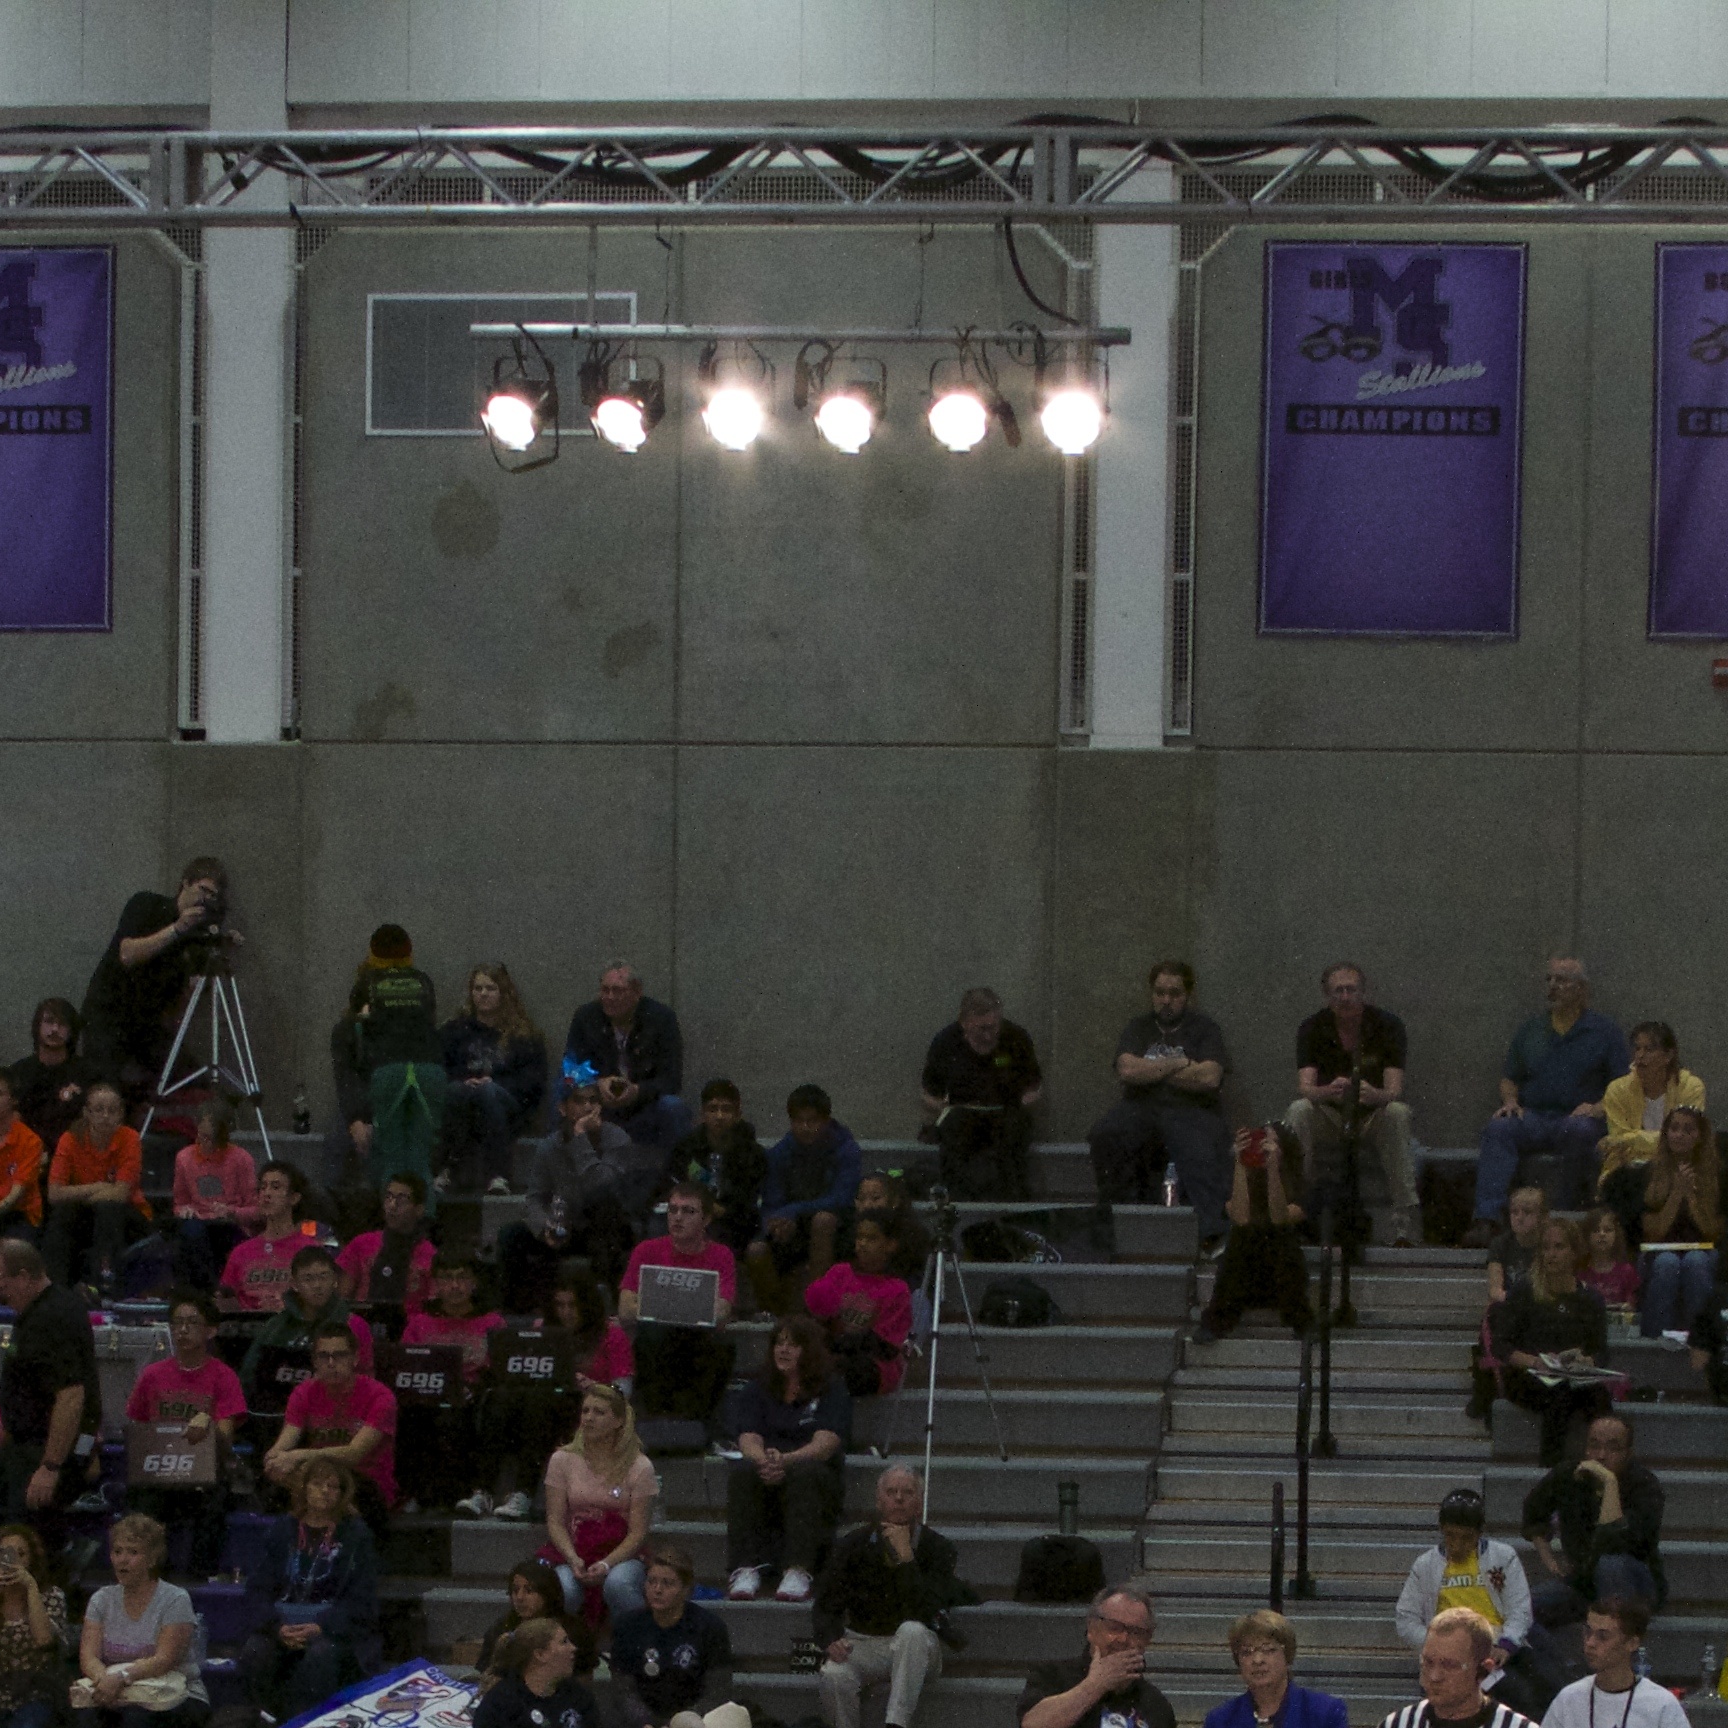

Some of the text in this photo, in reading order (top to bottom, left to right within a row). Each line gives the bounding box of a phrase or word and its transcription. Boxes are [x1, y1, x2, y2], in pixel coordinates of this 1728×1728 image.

[1296, 408, 1493, 432] CHAMPIONS
[655, 1270, 704, 1289] 696
[507, 1356, 555, 1374] 696
[275, 1367, 314, 1384] 69
[395, 1371, 445, 1389] 696
[143, 1454, 195, 1473] 696
